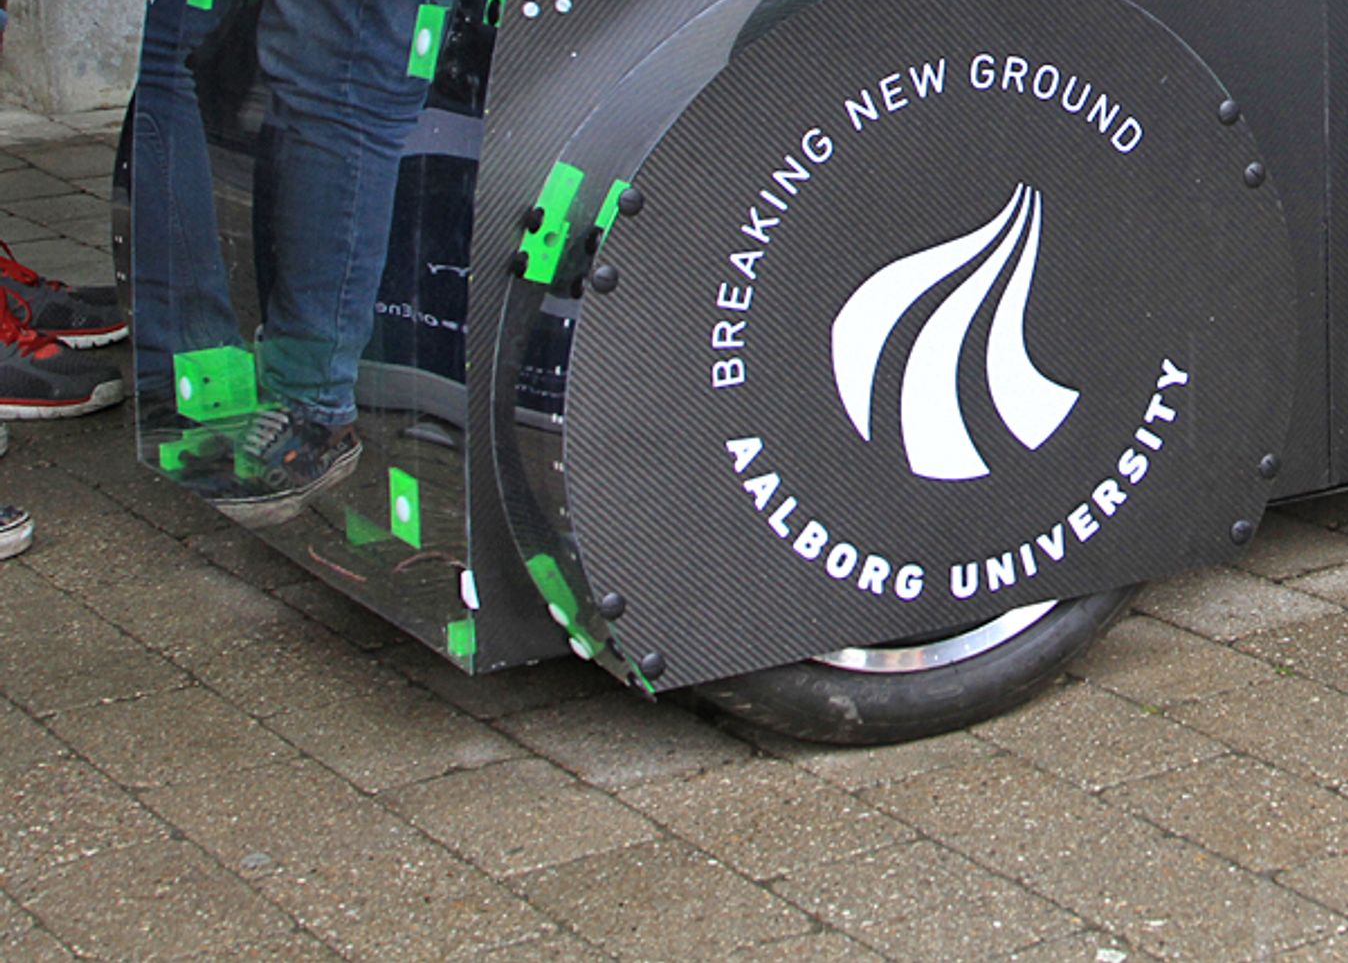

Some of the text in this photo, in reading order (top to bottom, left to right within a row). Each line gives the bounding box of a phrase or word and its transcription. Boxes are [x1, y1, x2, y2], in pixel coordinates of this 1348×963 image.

[712, 54, 1143, 387] BREAKING NEW GROUND
[726, 359, 1189, 600] AALBORG UNIVERSITY
